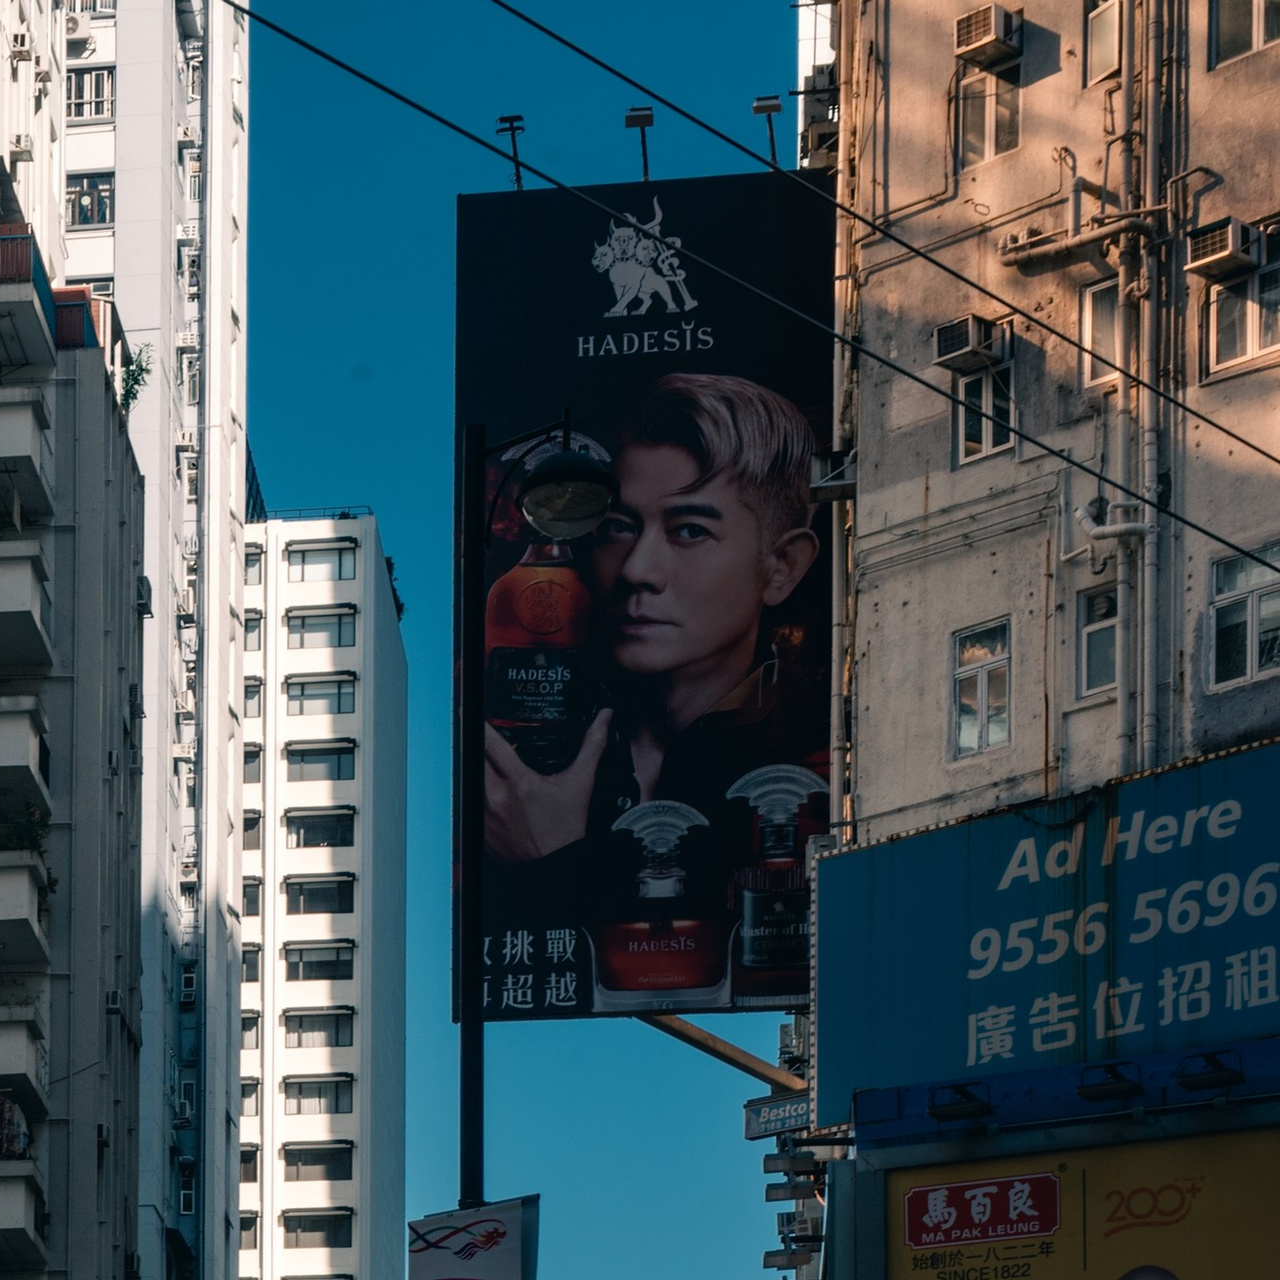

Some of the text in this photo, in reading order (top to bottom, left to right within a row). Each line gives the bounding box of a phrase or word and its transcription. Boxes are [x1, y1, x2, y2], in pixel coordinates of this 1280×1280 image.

[997, 800, 1242, 891] Ad Here
[967, 862, 1280, 980] 9556 5696
[483, 972, 577, 1011] 超越
[966, 946, 1280, 1067] 廣告位招租
[760, 1103, 807, 1123] Bestco
[922, 1181, 1040, 1229] 馬百良
[922, 1221, 1040, 1243] MA PAK LEUNG
[912, 1242, 1056, 1271] 始創於一八二二年
